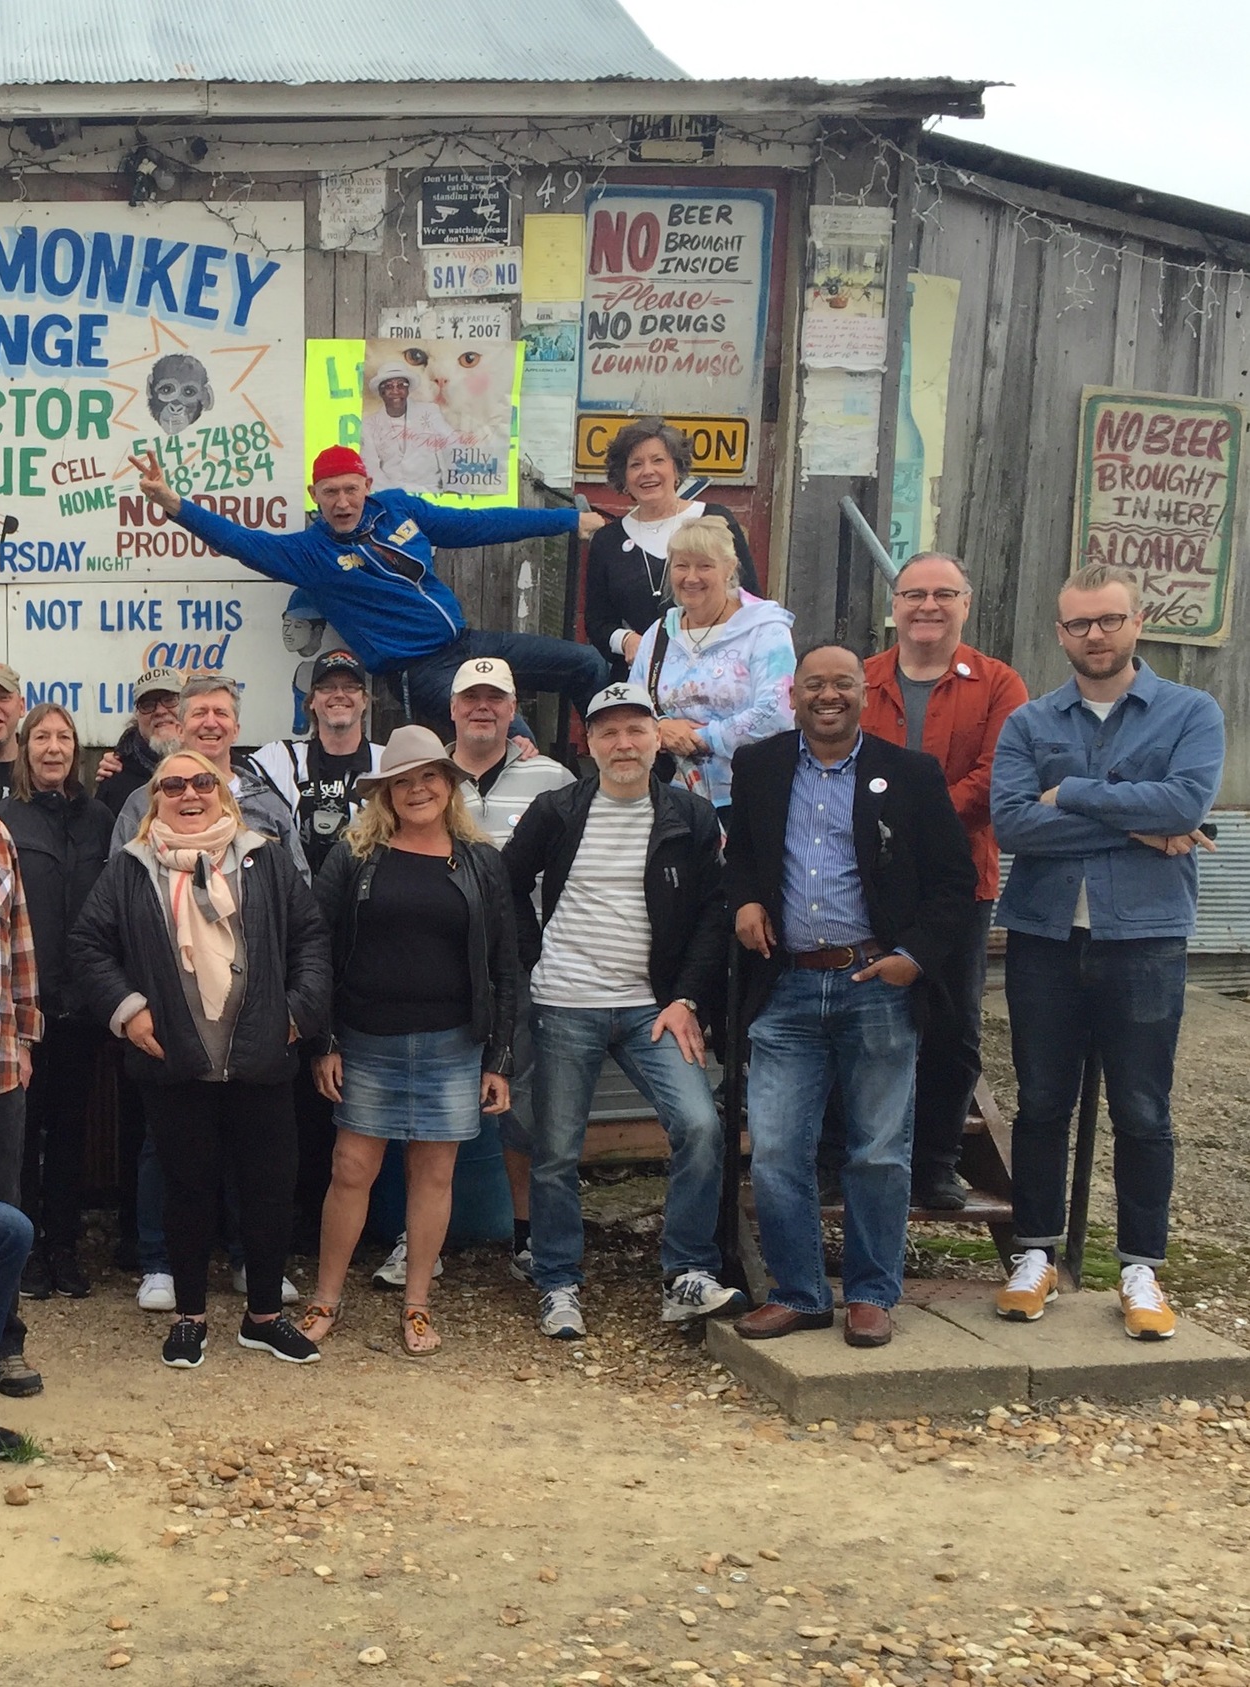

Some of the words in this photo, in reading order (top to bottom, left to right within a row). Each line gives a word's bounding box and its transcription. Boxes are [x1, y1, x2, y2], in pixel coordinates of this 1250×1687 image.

[423, 174, 446, 183] Don't
[448, 174, 459, 183] let
[461, 174, 474, 183] the
[446, 183, 469, 191] catch
[536, 170, 582, 208] 49
[432, 192, 468, 201] standing
[667, 203, 733, 227] BEER
[423, 226, 446, 235] We're
[448, 226, 482, 236] watching
[443, 235, 464, 243] don't
[588, 209, 661, 275] NO
[664, 232, 747, 253] BROUGHT
[433, 265, 467, 289] SAY
[495, 262, 517, 285] NO
[657, 256, 740, 275] INSIDE
[602, 281, 713, 312] Please
[469, 324, 501, 338] 2007
[587, 310, 632, 341] NO
[638, 313, 726, 336] DRUGS
[648, 337, 680, 354] OR
[671, 352, 744, 377] MUSIC
[1096, 409, 1144, 452] NO
[1142, 413, 1232, 462] BEER
[452, 447, 491, 465] Billy
[51, 456, 106, 485] CELL
[447, 468, 502, 486] Bonds
[1094, 462, 1228, 499] BROUGHT
[58, 484, 117, 517] HOME
[119, 495, 168, 527] NO
[191, 494, 288, 529] DRUG
[1112, 496, 1149, 521] IN
[86, 556, 133, 572] NIGHT
[1085, 532, 1218, 576] ALCOHOL
[25, 599, 83, 632] NOT
[100, 599, 163, 632] LIKE
[177, 599, 243, 632] THIS
[146, 633, 232, 671] and
[25, 681, 83, 713] NOT
[604, 686, 630, 702] NY
